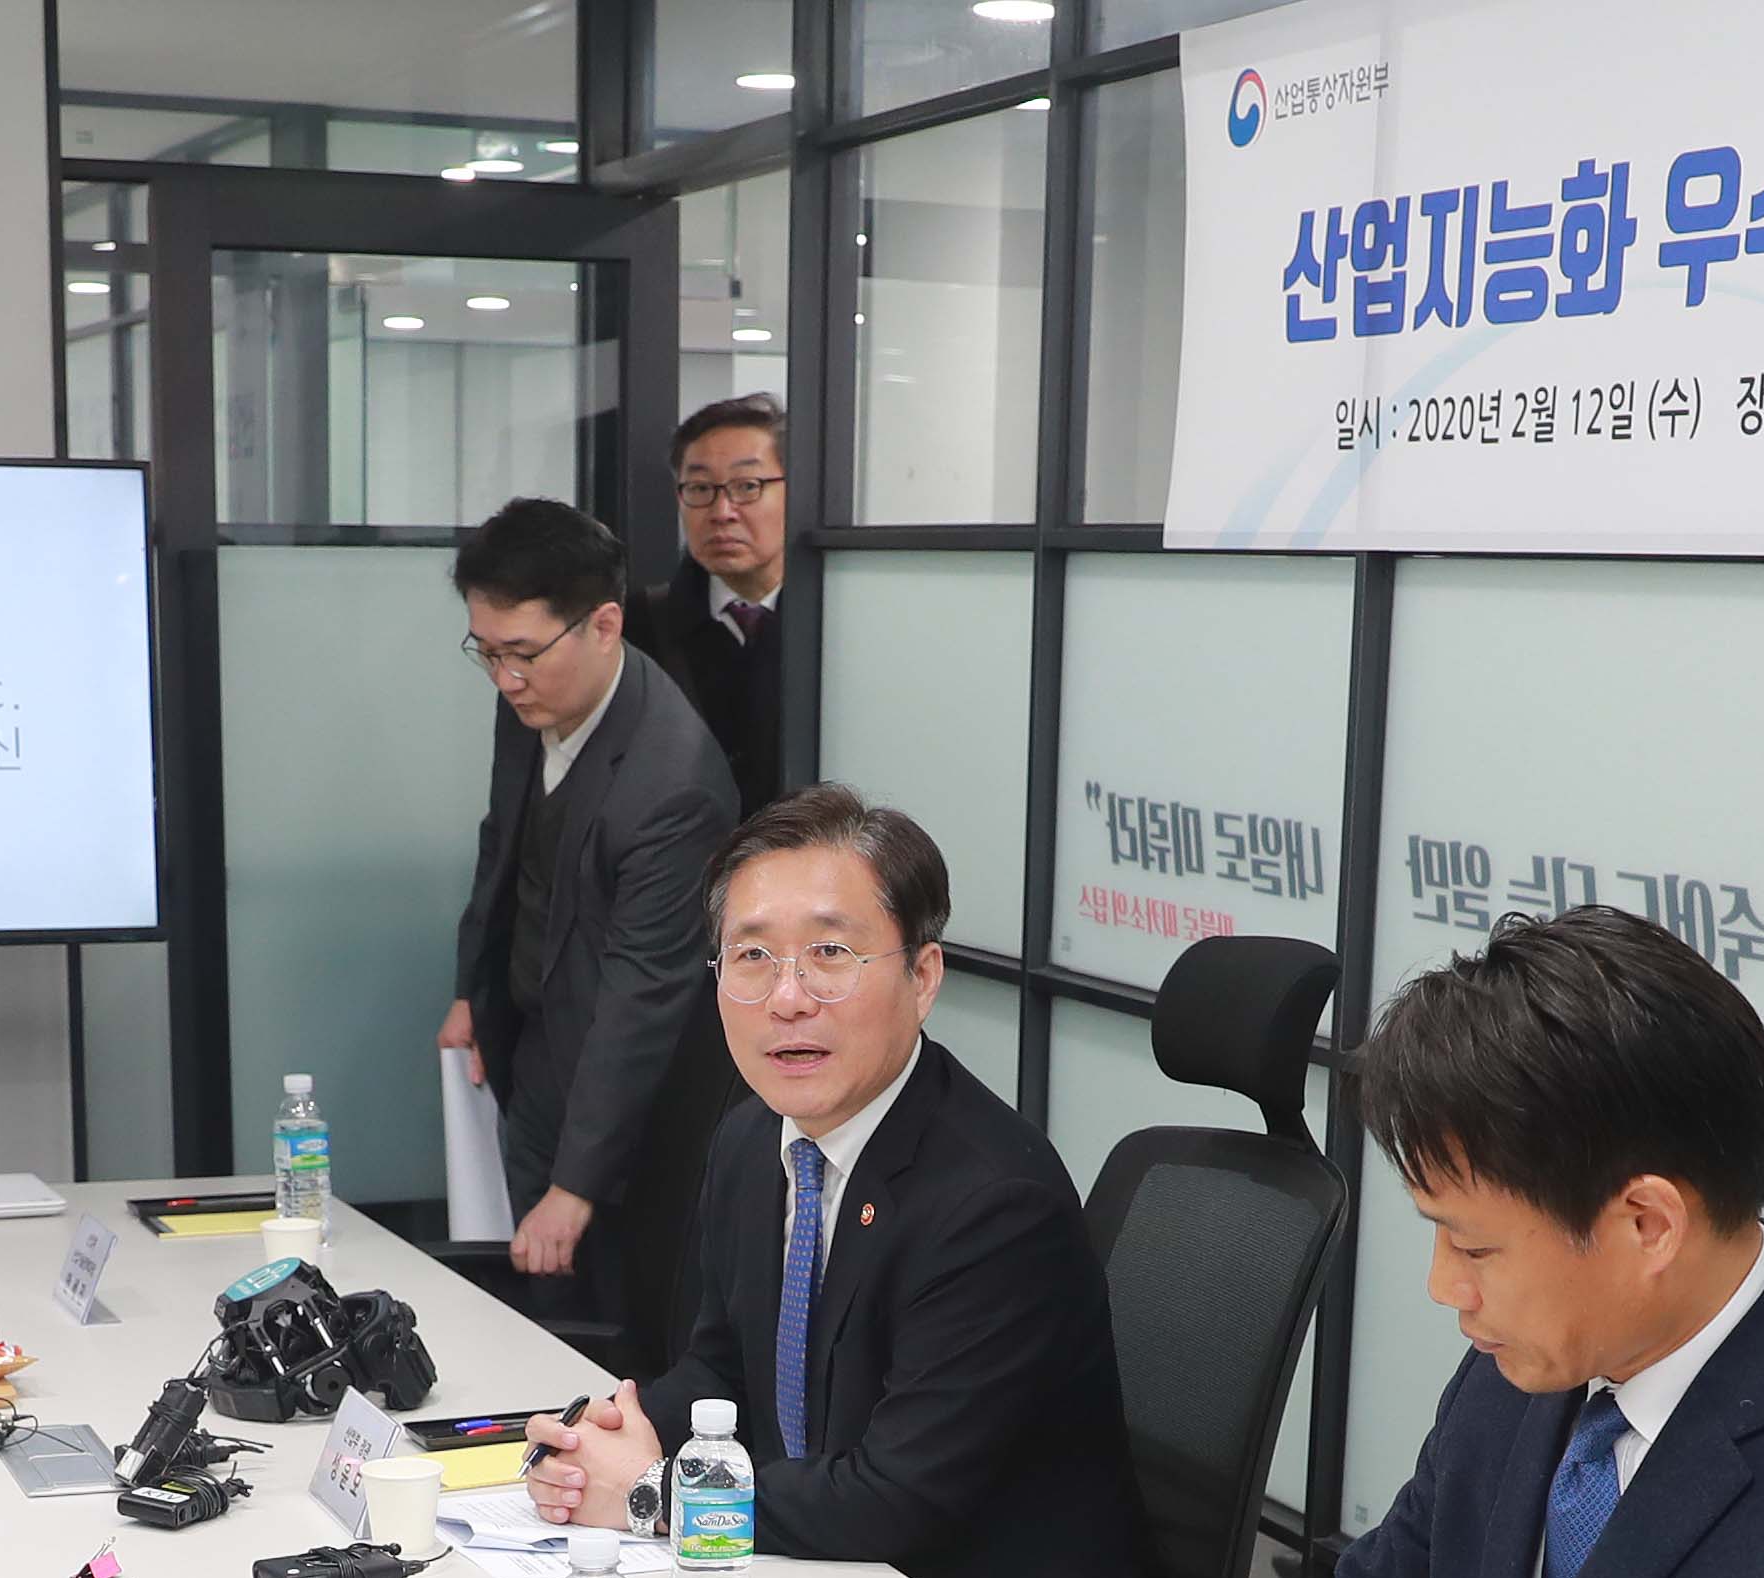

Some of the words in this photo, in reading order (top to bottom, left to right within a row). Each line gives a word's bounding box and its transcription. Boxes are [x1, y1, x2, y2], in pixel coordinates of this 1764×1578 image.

[1274, 61, 1390, 121] 산업통상자원부
[1283, 158, 1637, 343] 산업지능화
[1335, 396, 1381, 450] 일시
[1408, 388, 1503, 444] 2020년
[1511, 384, 1559, 444] 2월
[1572, 380, 1636, 441] 12일
[1648, 376, 1702, 441] (수)
